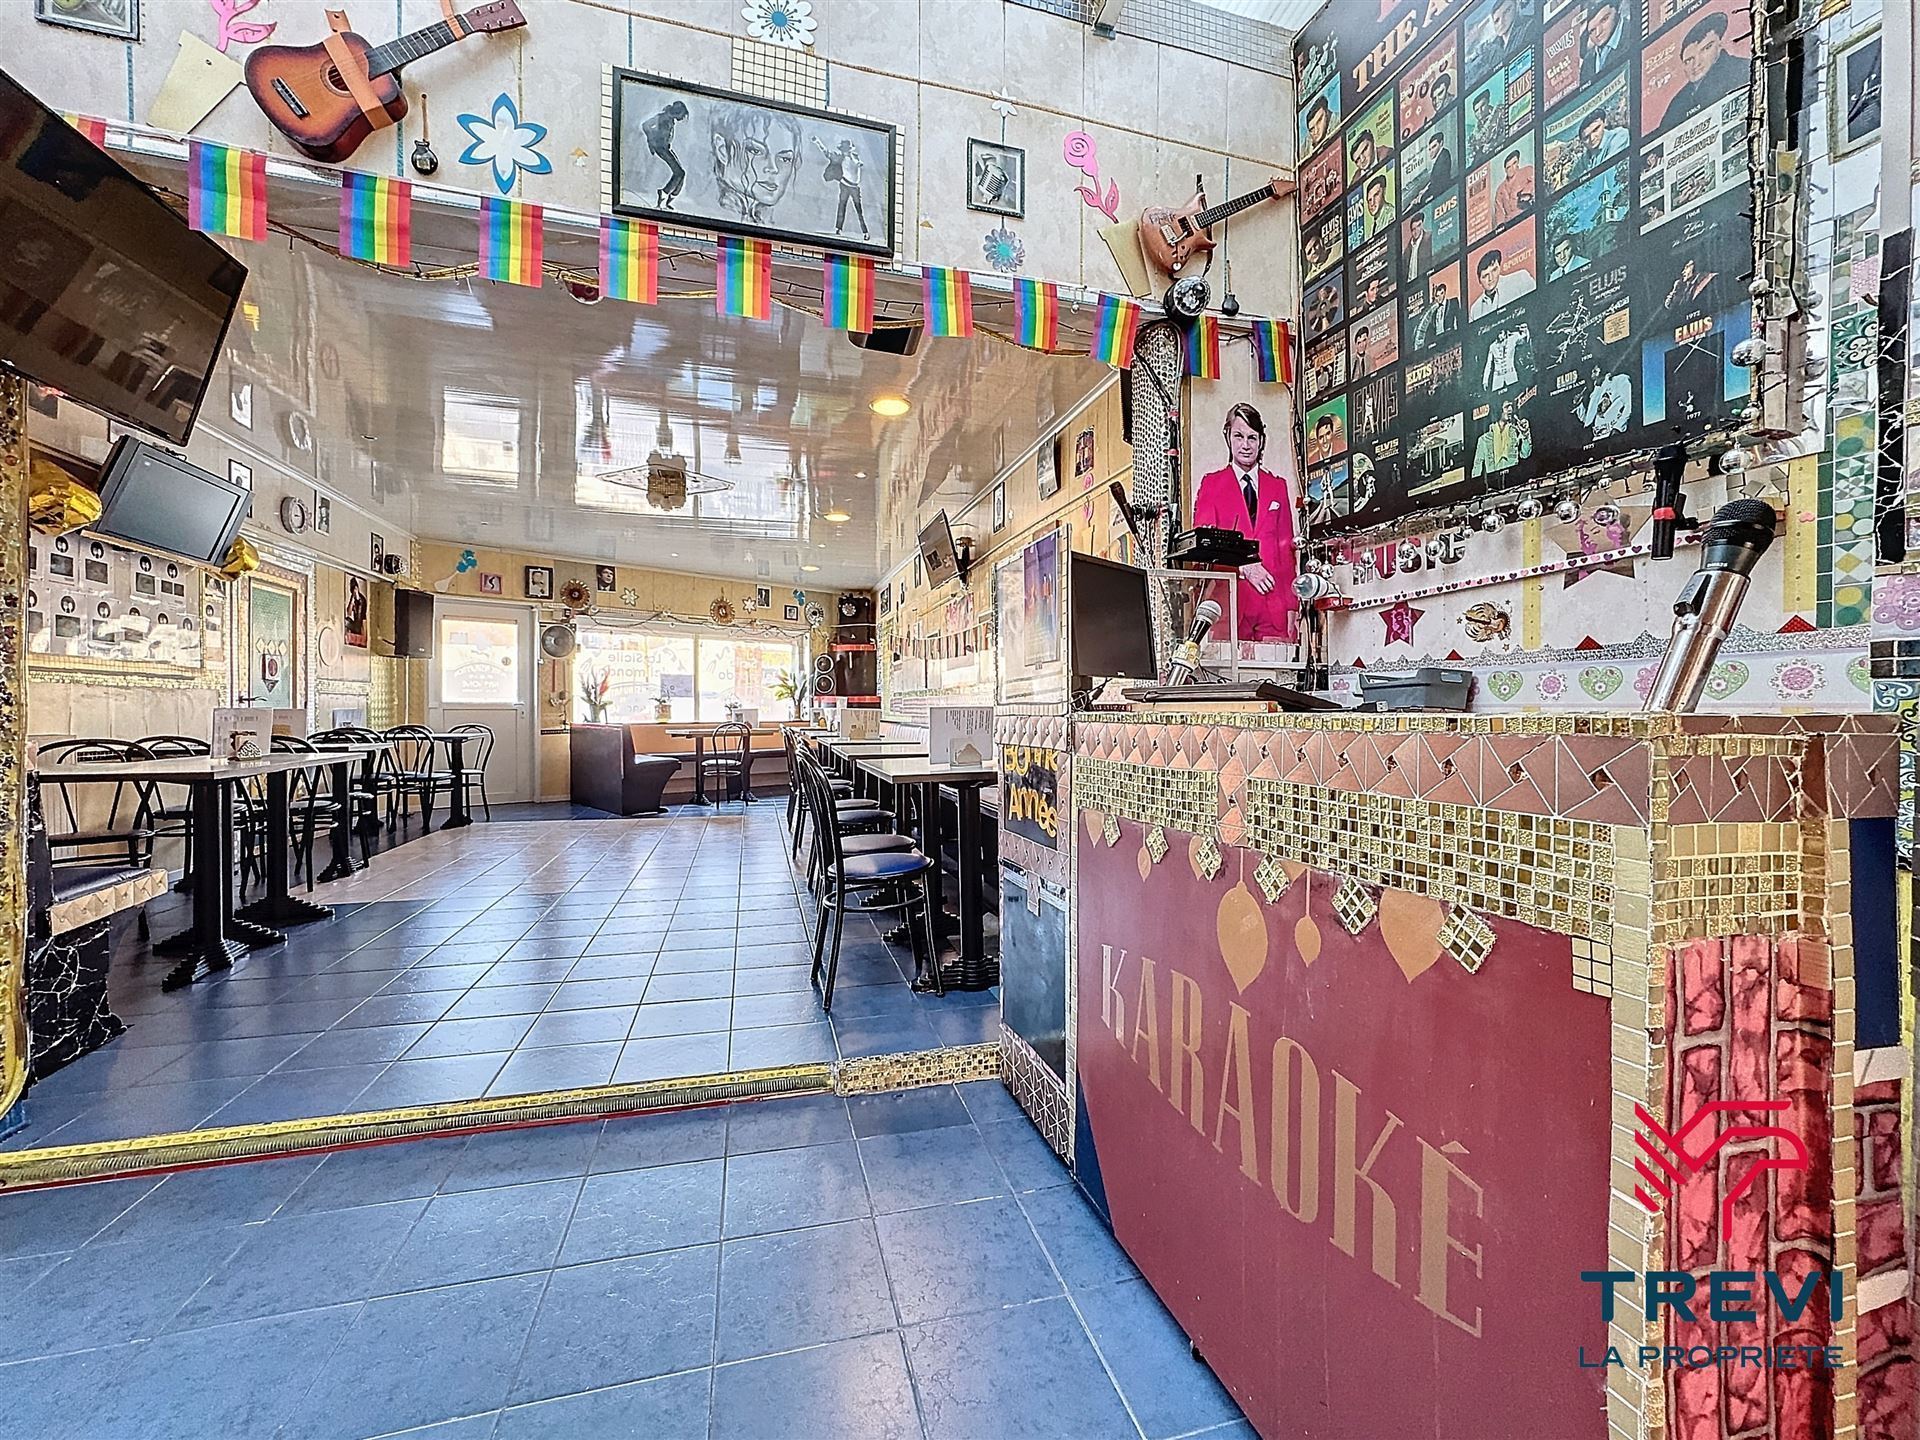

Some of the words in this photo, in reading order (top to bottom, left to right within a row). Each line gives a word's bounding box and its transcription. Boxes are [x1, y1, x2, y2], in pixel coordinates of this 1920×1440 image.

[1352, 9, 1418, 93] THE
[1511, 73, 1530, 100] ELVIS
[1674, 117, 1712, 149] ELVIS
[1468, 167, 1488, 187] ELVIS
[1348, 202, 1363, 225] ELVIS
[1434, 195, 1457, 219] ELVIS
[1322, 215, 1340, 239] ELVIS
[1590, 265, 1627, 296] ELVIS
[1408, 290, 1424, 304] ELVIS
[1370, 309, 1390, 327] ELVIS
[1674, 316, 1713, 343] ELVIS
[1406, 364, 1433, 385] ELVIS
[1557, 371, 1577, 389] ELVIS
[1515, 386, 1537, 408] Today
[1686, 411, 1701, 420] 1977
[1375, 438, 1399, 454] ELVIS
[1008, 782, 1057, 838] Année
[1101, 943, 1483, 1339] KARAOKÉ
